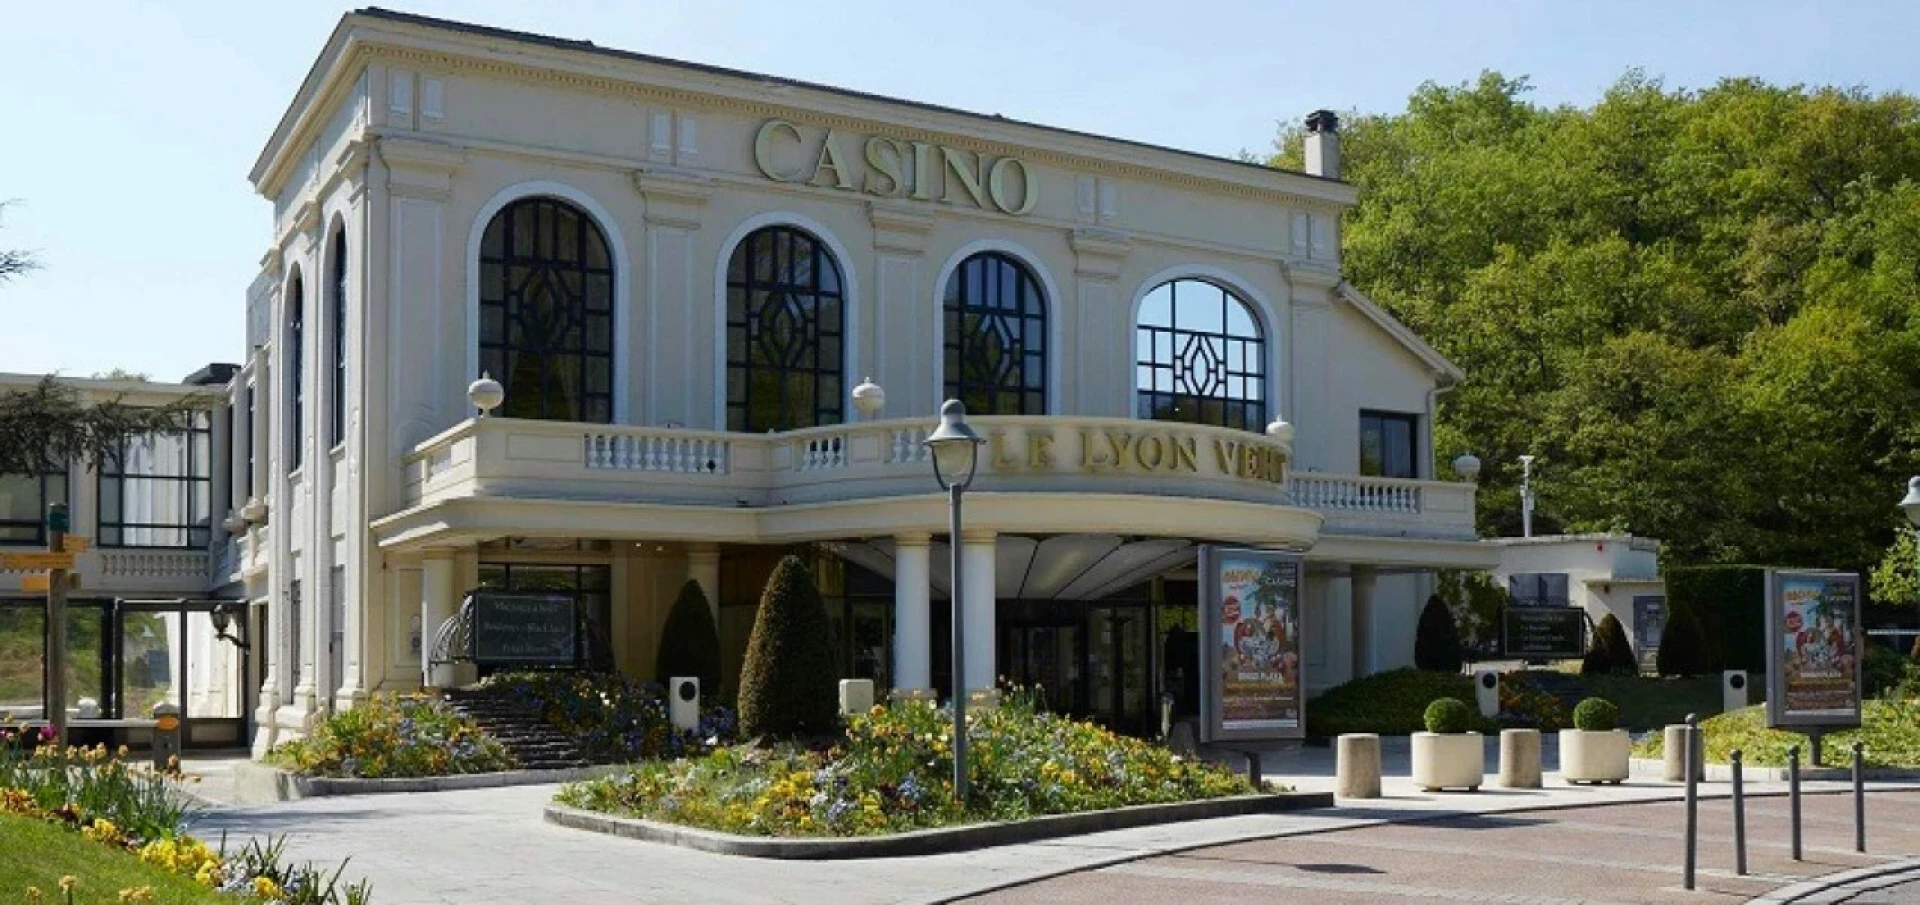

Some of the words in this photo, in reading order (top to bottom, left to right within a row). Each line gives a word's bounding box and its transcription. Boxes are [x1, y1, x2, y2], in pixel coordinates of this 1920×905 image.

[754, 118, 1038, 215] CASINO
[990, 431, 1055, 470] LE
[1079, 431, 1197, 472] LYON
